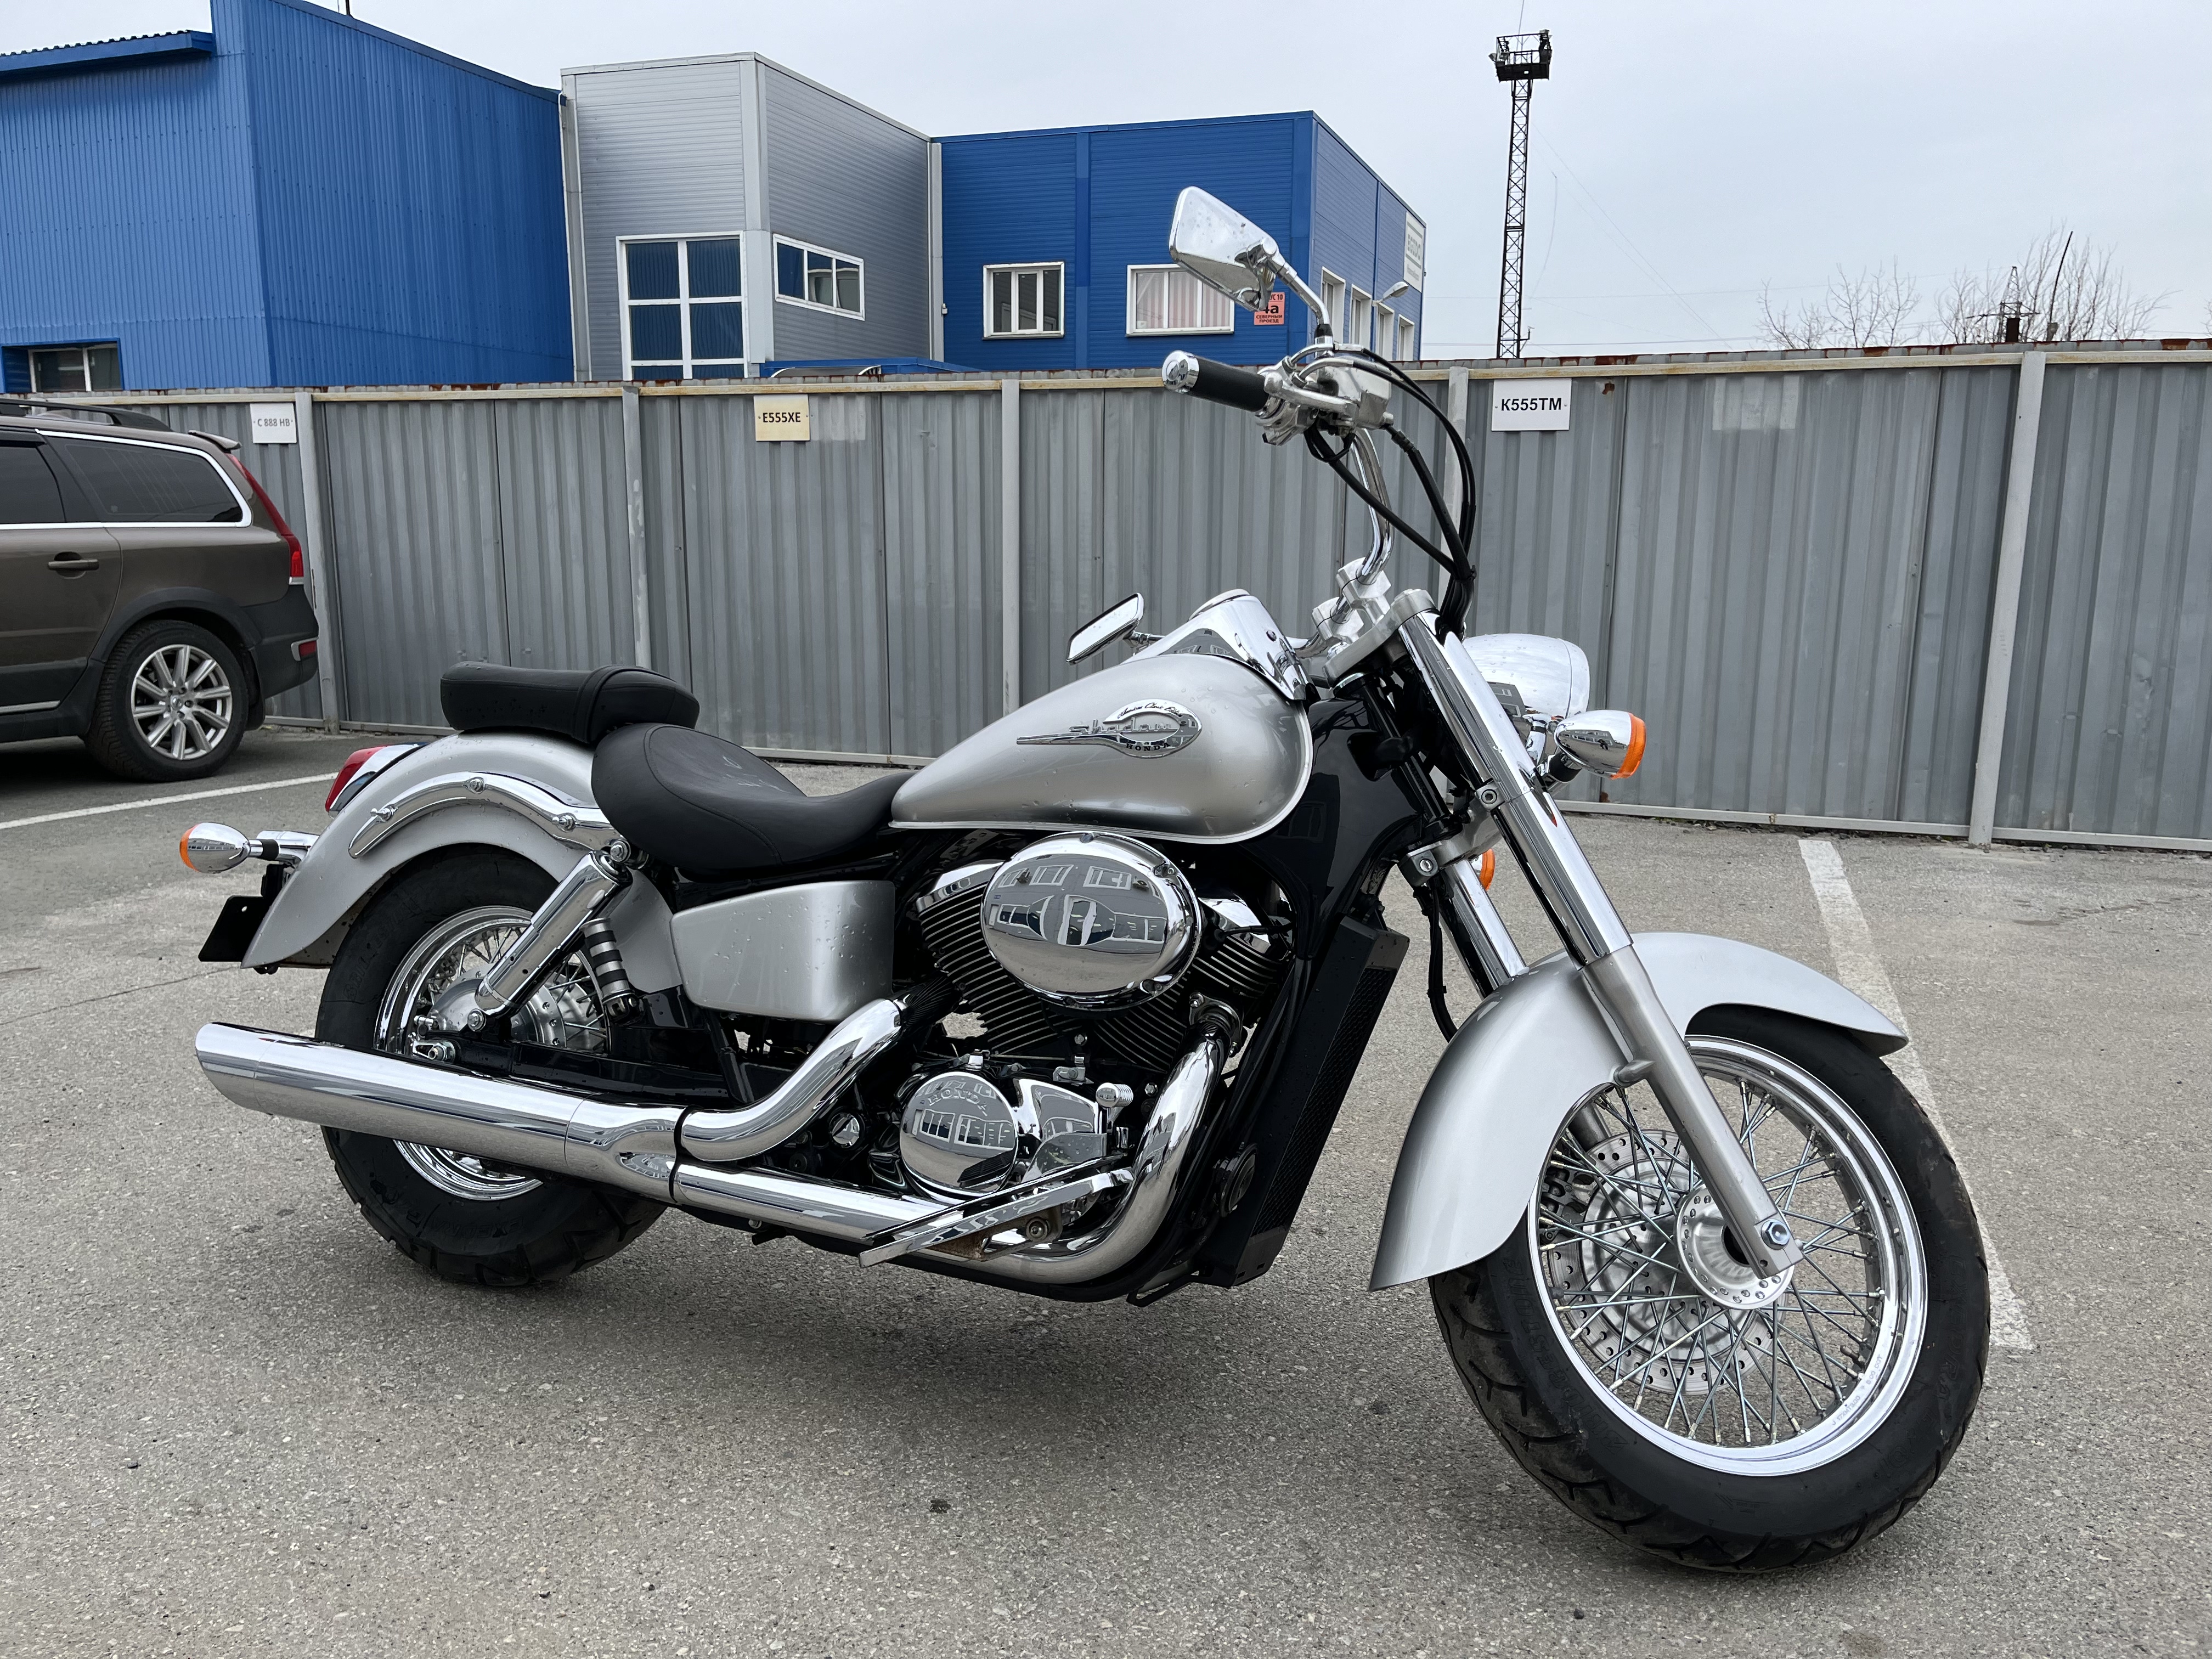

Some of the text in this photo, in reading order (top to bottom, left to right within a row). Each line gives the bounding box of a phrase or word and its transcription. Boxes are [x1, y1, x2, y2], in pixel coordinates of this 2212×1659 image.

[264, 419, 278, 427] 888
[1126, 742, 1170, 752] HONDA
[927, 1087, 988, 1116] HONDA
[1503, 1258, 1629, 1455] BRIDGESTONE
